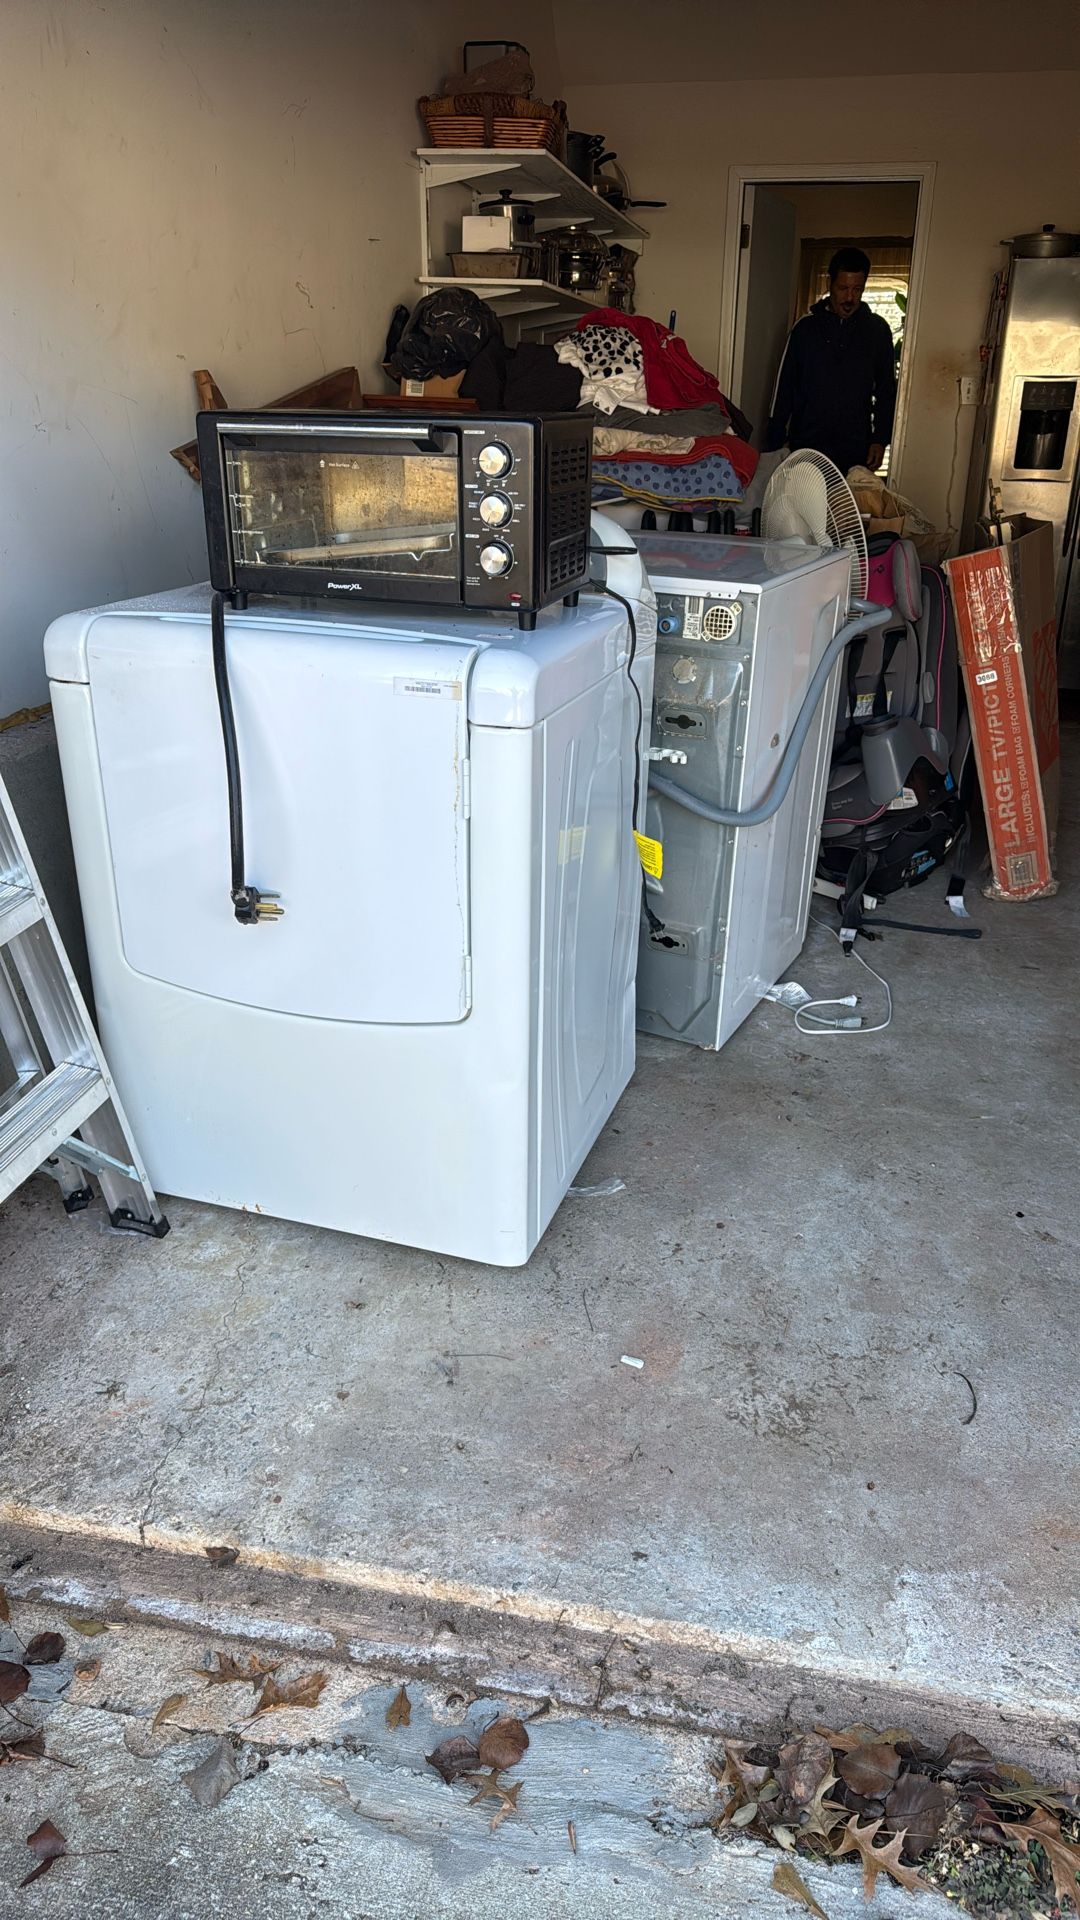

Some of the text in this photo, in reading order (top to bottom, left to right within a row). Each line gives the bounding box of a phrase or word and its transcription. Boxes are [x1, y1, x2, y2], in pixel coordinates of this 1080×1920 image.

[327, 582, 362, 591] PowerXL
[1002, 656, 1015, 699] CORNERS
[976, 641, 1008, 762] TV/PICT
[1008, 700, 1020, 727] FOAM
[1014, 735, 1024, 755] BAG
[1017, 756, 1027, 781] FOAM
[992, 767, 1021, 848] LARGE
